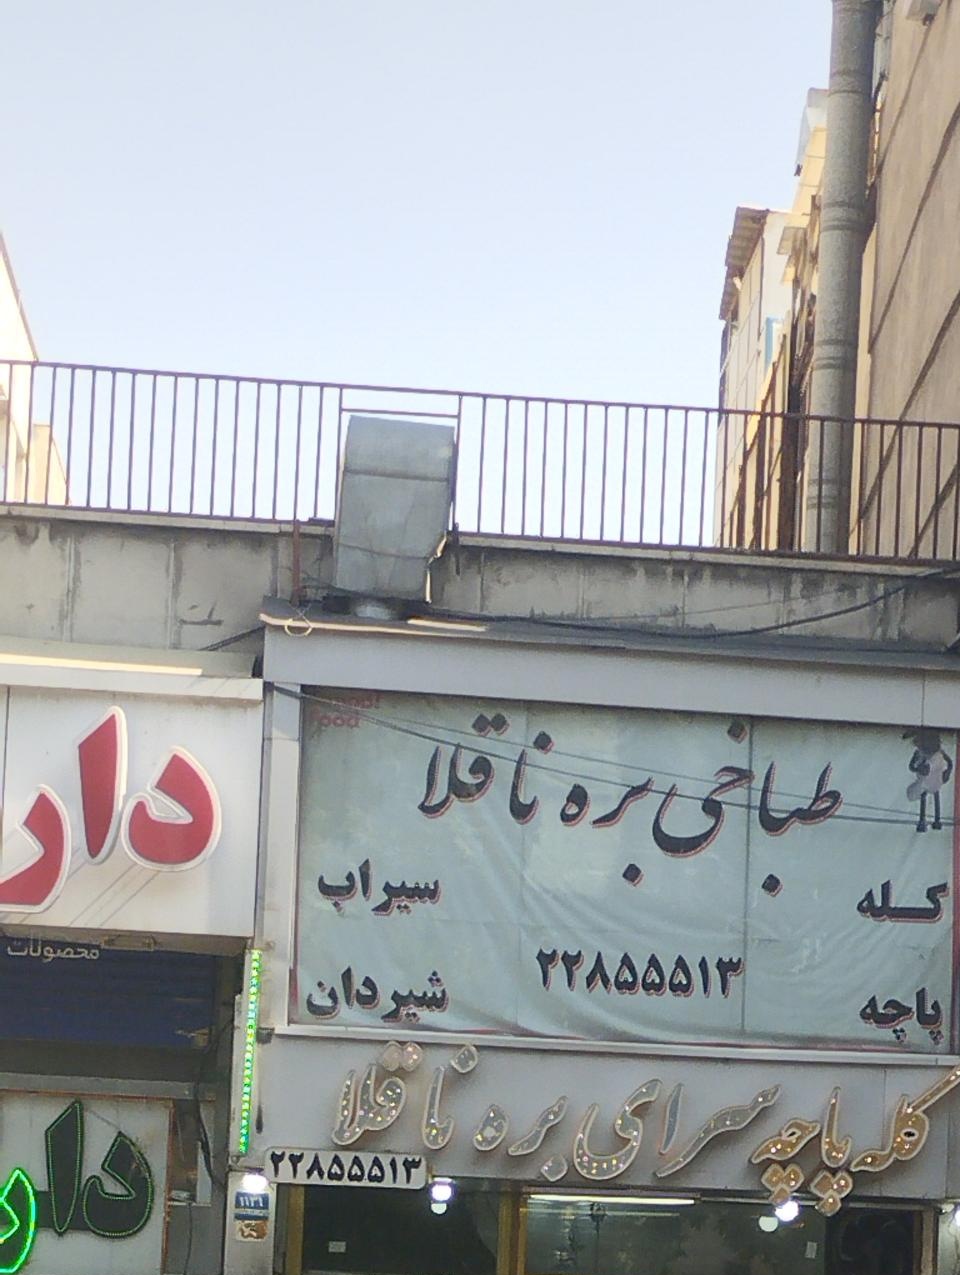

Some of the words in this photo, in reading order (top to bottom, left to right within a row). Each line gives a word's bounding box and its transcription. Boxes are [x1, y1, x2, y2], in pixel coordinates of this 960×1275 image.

[418, 713, 555, 826] ناقلا
[560, 777, 655, 886] بره
[652, 717, 842, 896] طباخی
[316, 858, 441, 915] سیراب
[856, 879, 949, 921] کله
[7, 932, 100, 963] محصولات
[536, 947, 746, 997] ۲۲۸۵۵۵۱۳
[306, 967, 449, 1023] شیردان
[859, 987, 943, 1041] پاچه
[331, 1039, 479, 1148] ناقلا
[572, 1078, 782, 1181] سرای
[269, 1150, 422, 1185] ۲۲۸۵۵۵۱۳
[472, 1096, 569, 1183] بره
[750, 1086, 853, 1216] پاچه
